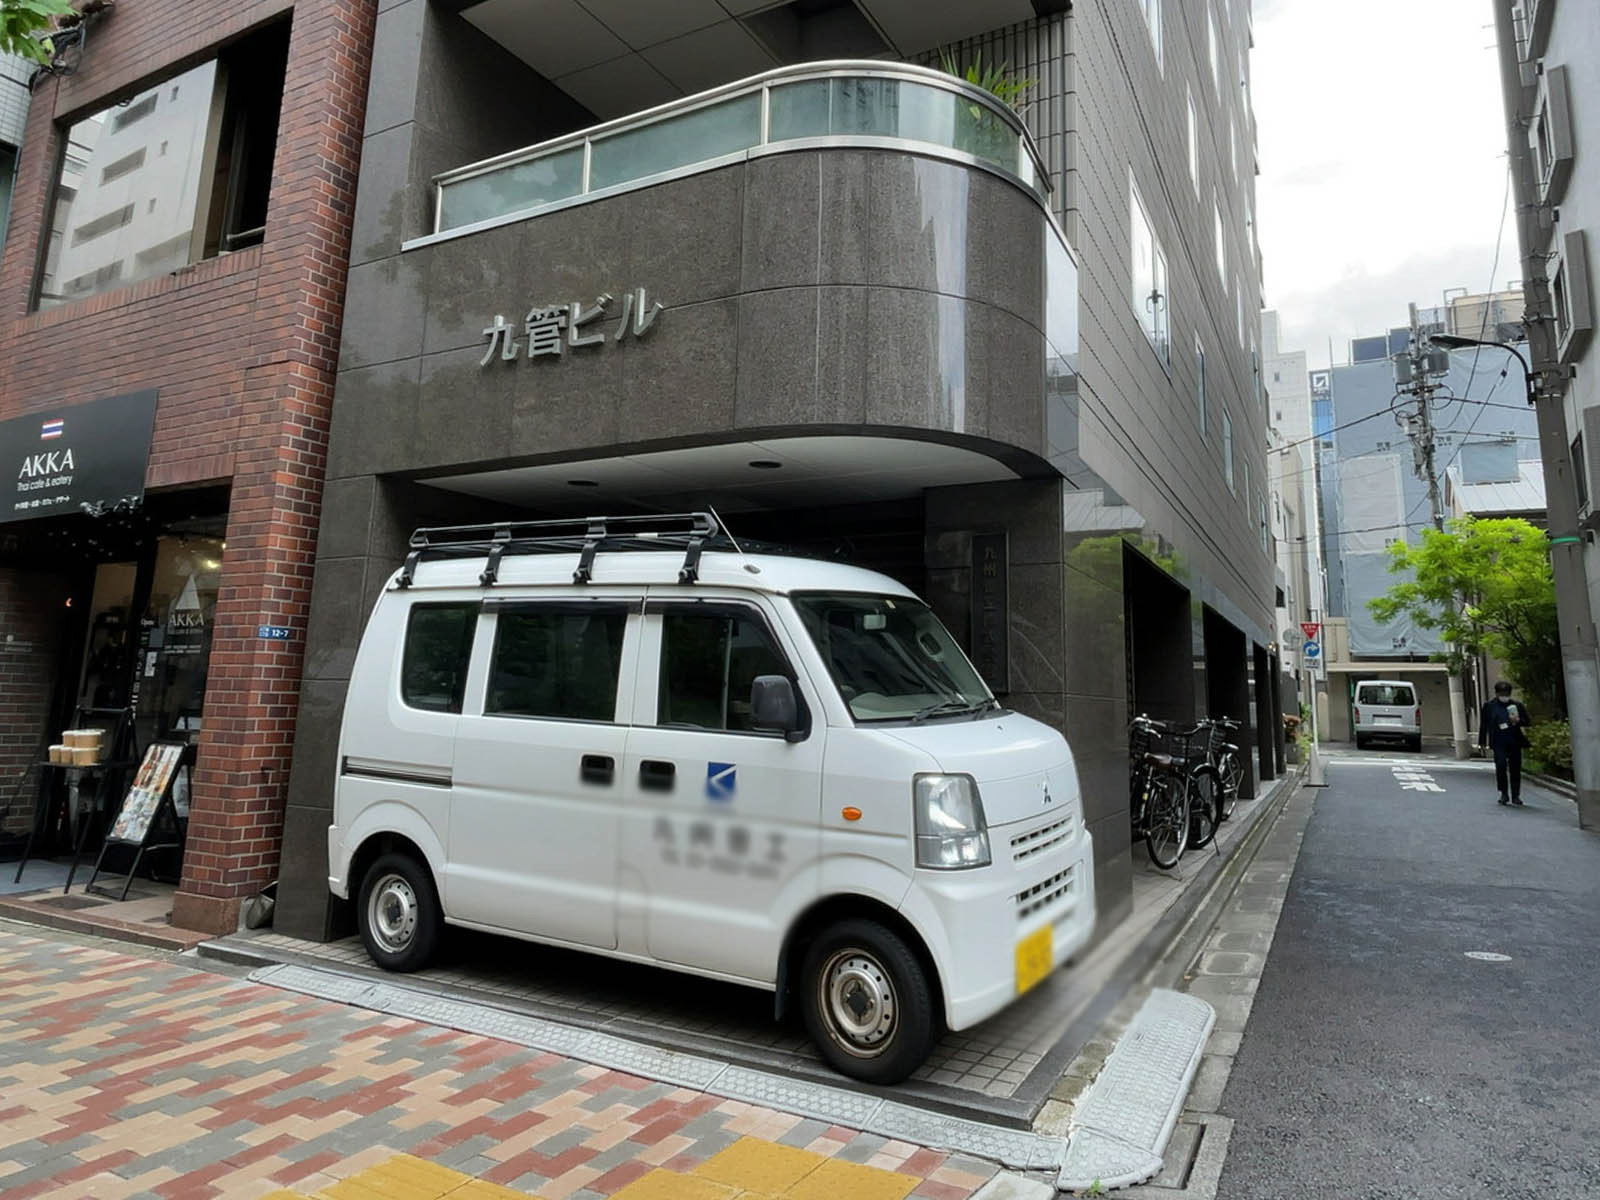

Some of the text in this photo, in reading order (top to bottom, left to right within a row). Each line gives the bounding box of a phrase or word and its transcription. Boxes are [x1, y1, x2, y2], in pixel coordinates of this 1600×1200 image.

[480, 287, 664, 366] 九管ビル
[18, 448, 74, 479] AKKA
[45, 478, 51, 488] &
[169, 613, 205, 627] AKKA
[272, 629, 289, 638] 12-7
